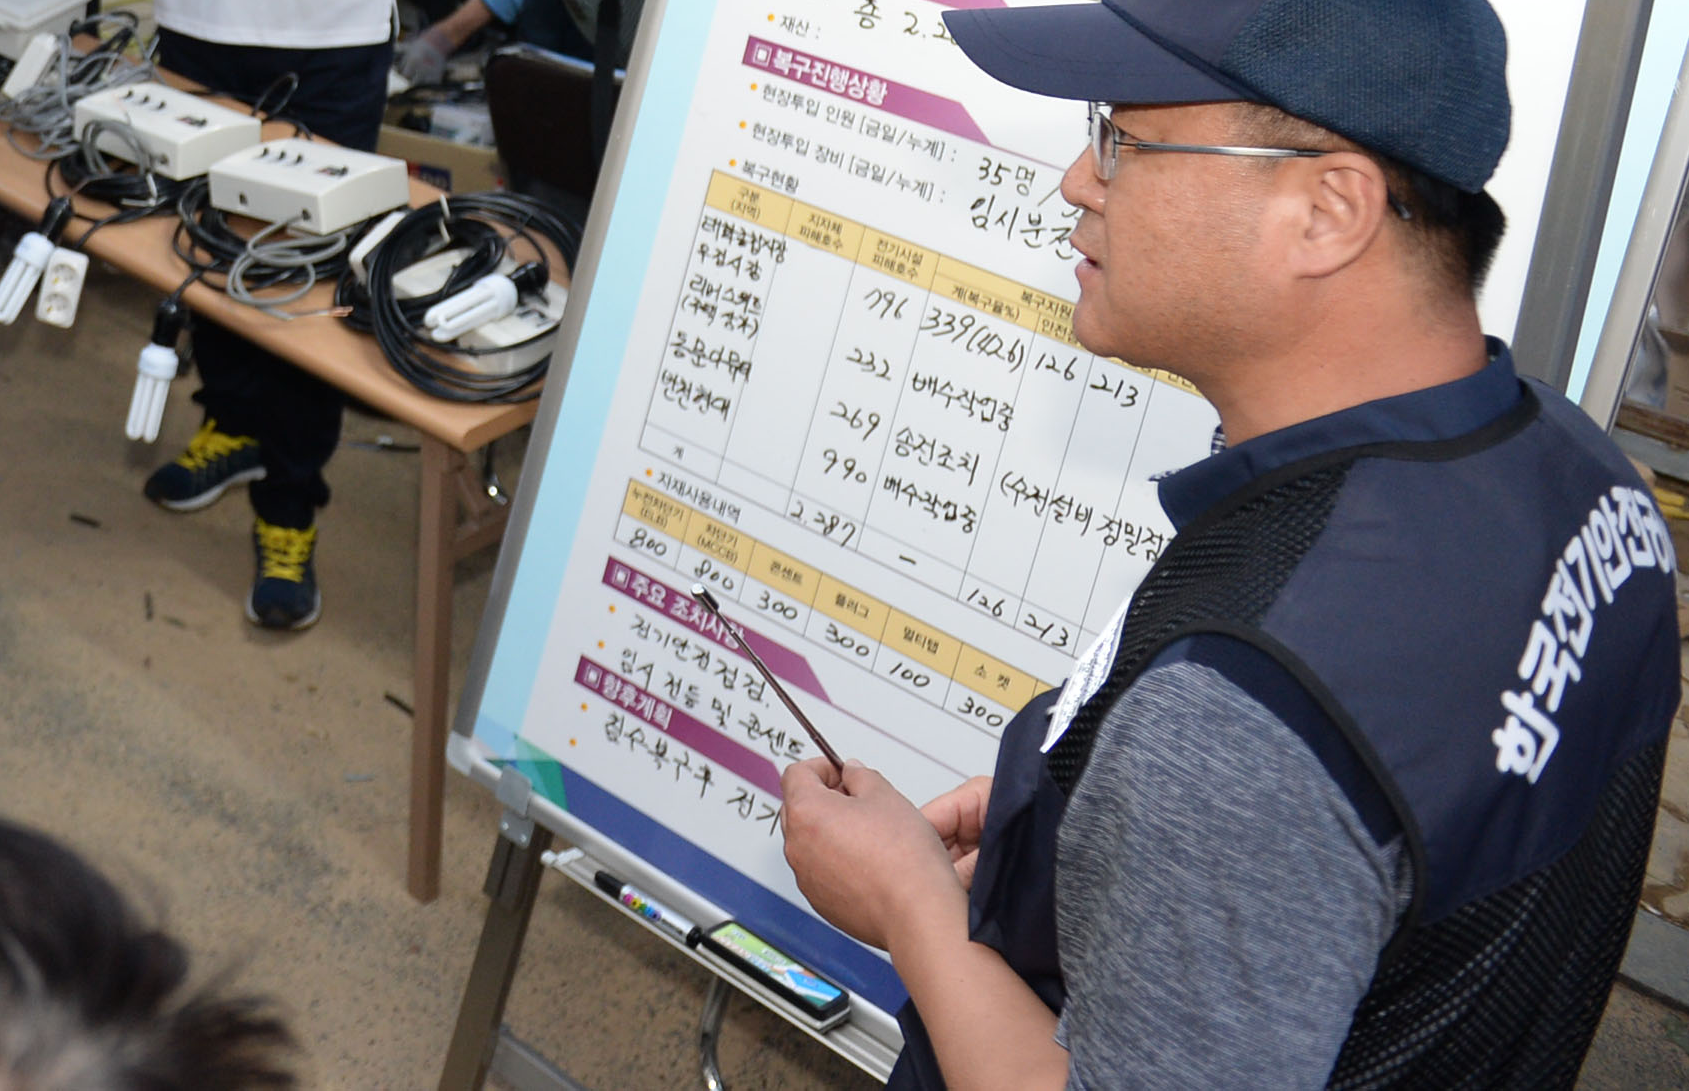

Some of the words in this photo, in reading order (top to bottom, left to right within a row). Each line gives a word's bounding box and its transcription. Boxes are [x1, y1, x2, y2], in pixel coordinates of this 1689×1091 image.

[779, 13, 810, 38] 재산
[772, 48, 888, 107] 복구진행상황
[762, 83, 821, 118] 현장투입
[826, 105, 856, 129] 인원
[752, 121, 811, 158] 현장투입
[814, 144, 846, 169] 장비
[741, 159, 800, 194] 복구현황
[863, 287, 910, 321] 796
[845, 347, 892, 382] 232
[1034, 352, 1078, 382] 126
[1089, 373, 1139, 408] 213
[828, 400, 882, 442] 269
[822, 448, 868, 484] 990
[628, 526, 668, 557] 800
[630, 574, 668, 610] 주요
[756, 589, 799, 620] 300
[966, 588, 1006, 618] 126
[824, 622, 870, 658] 300
[1023, 613, 1069, 648] 213
[888, 661, 931, 689] 100
[602, 674, 674, 732] 향후계획
[957, 696, 1004, 729] 300
